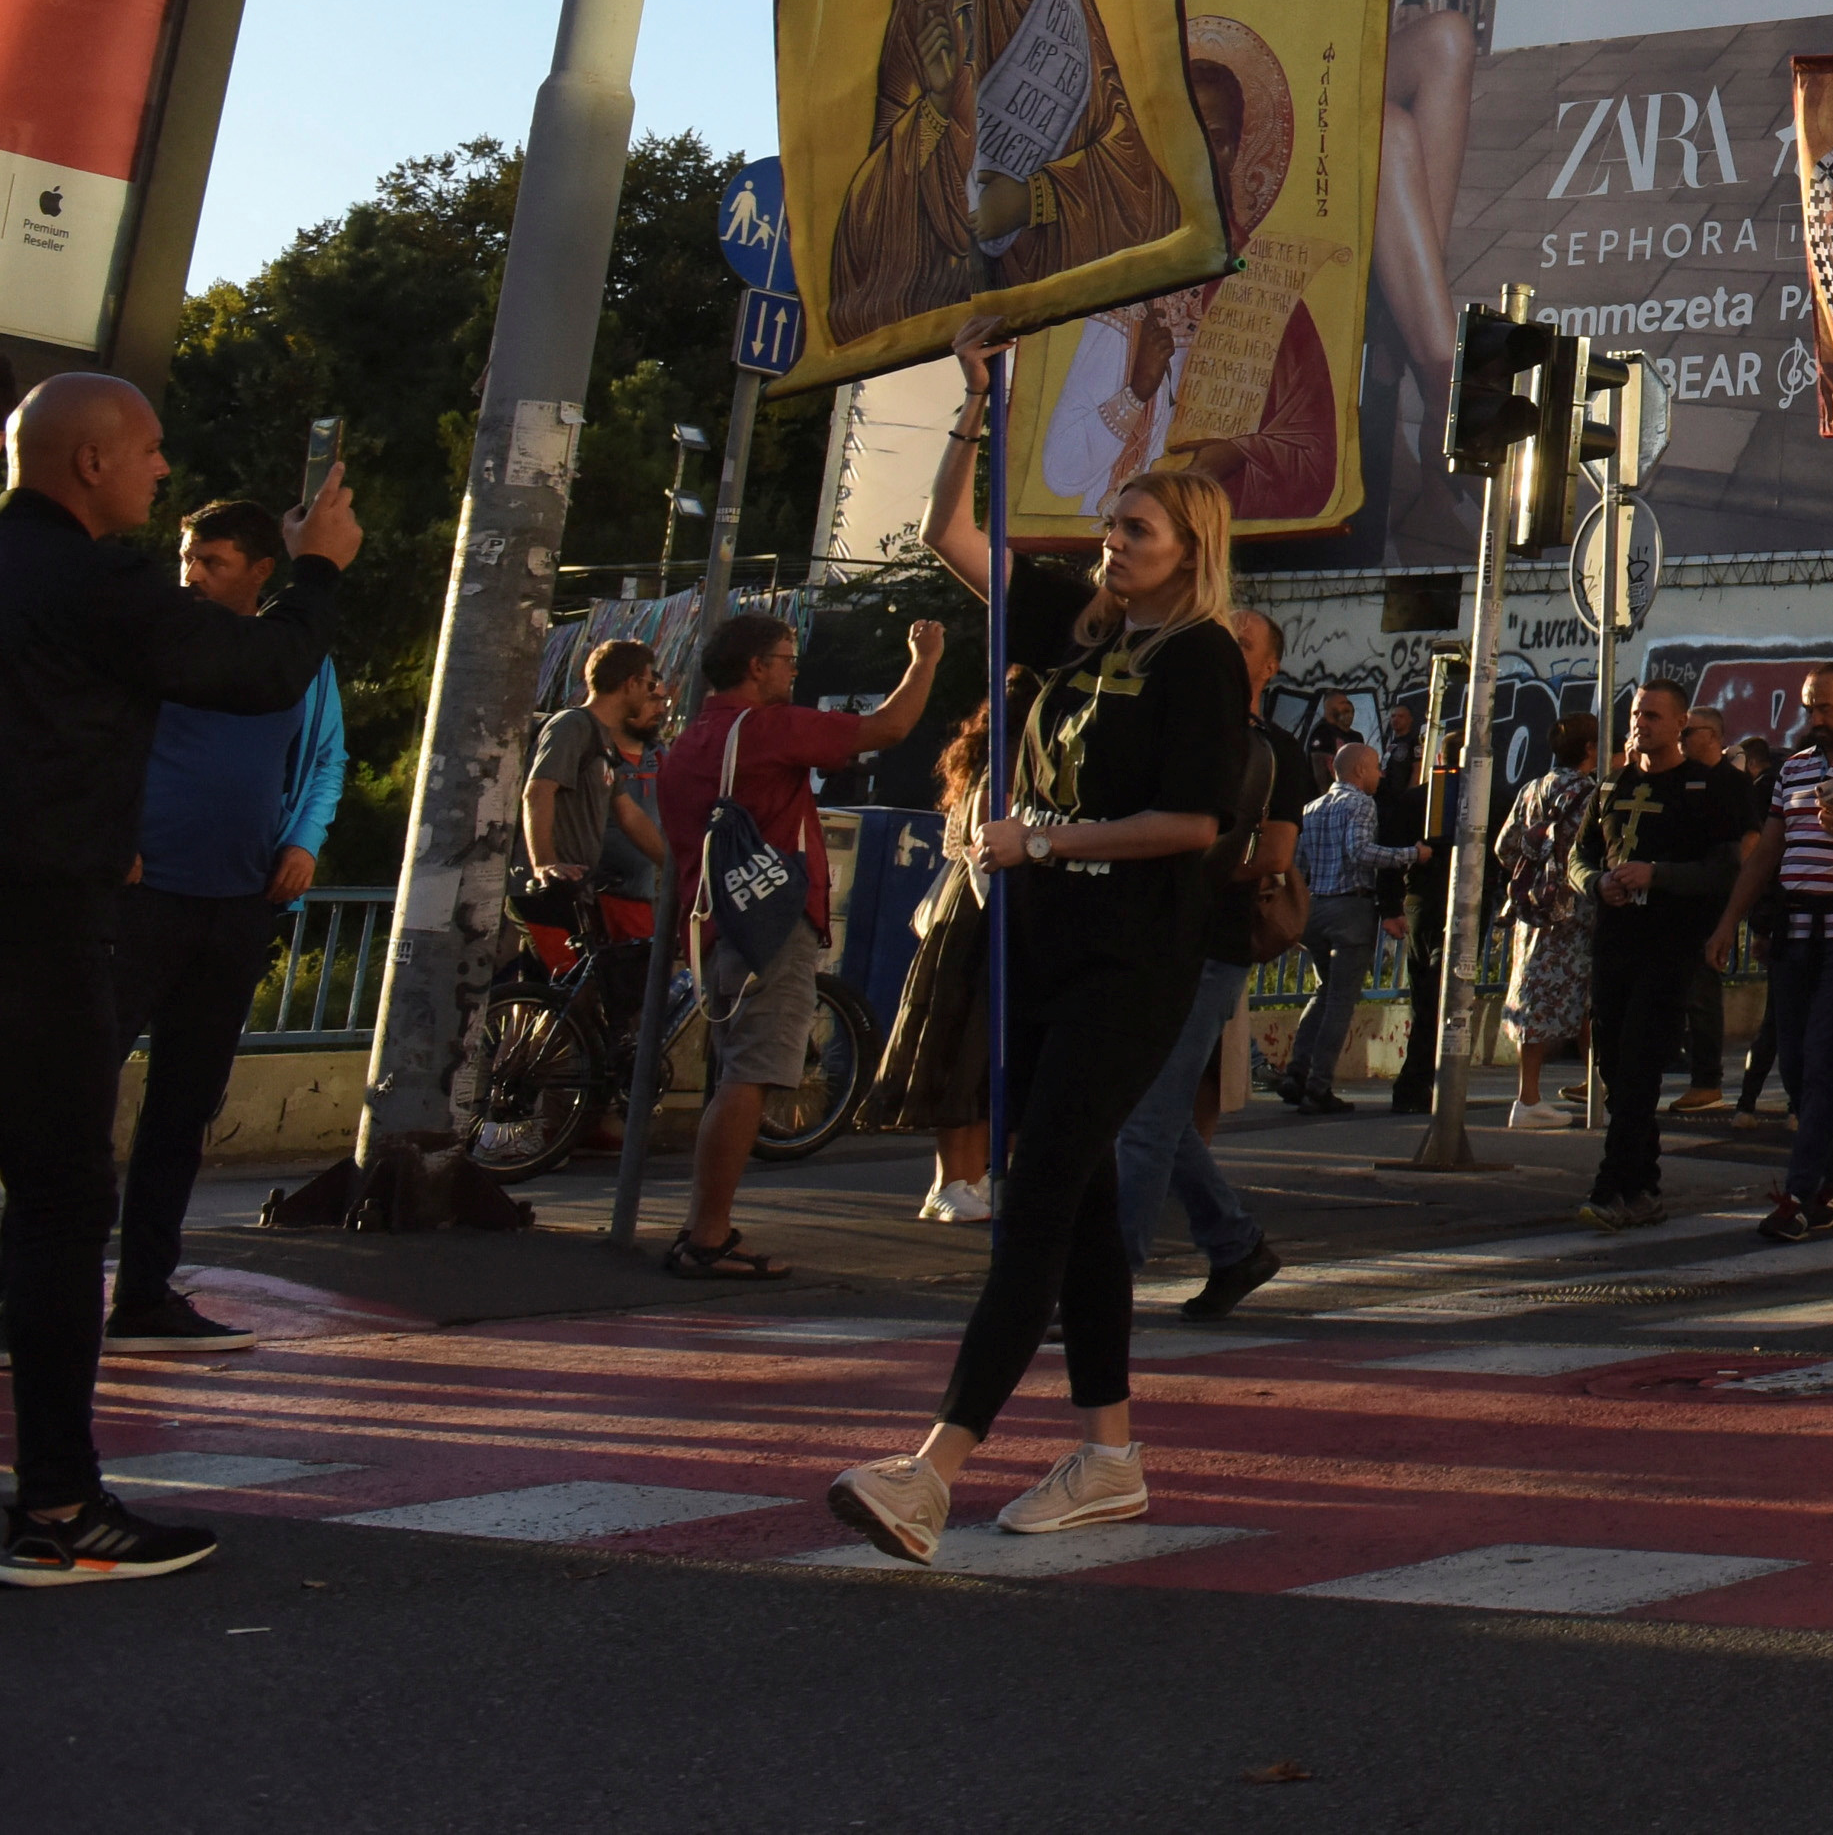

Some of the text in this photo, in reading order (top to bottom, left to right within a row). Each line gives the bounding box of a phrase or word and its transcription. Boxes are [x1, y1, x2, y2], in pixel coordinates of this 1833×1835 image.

[1547, 85, 1748, 200] ZARA
[23, 218, 69, 239] Premium
[24, 234, 65, 252] Reseller
[1540, 218, 1757, 269] SEPHORA
[1536, 286, 1754, 337] emmezeta
